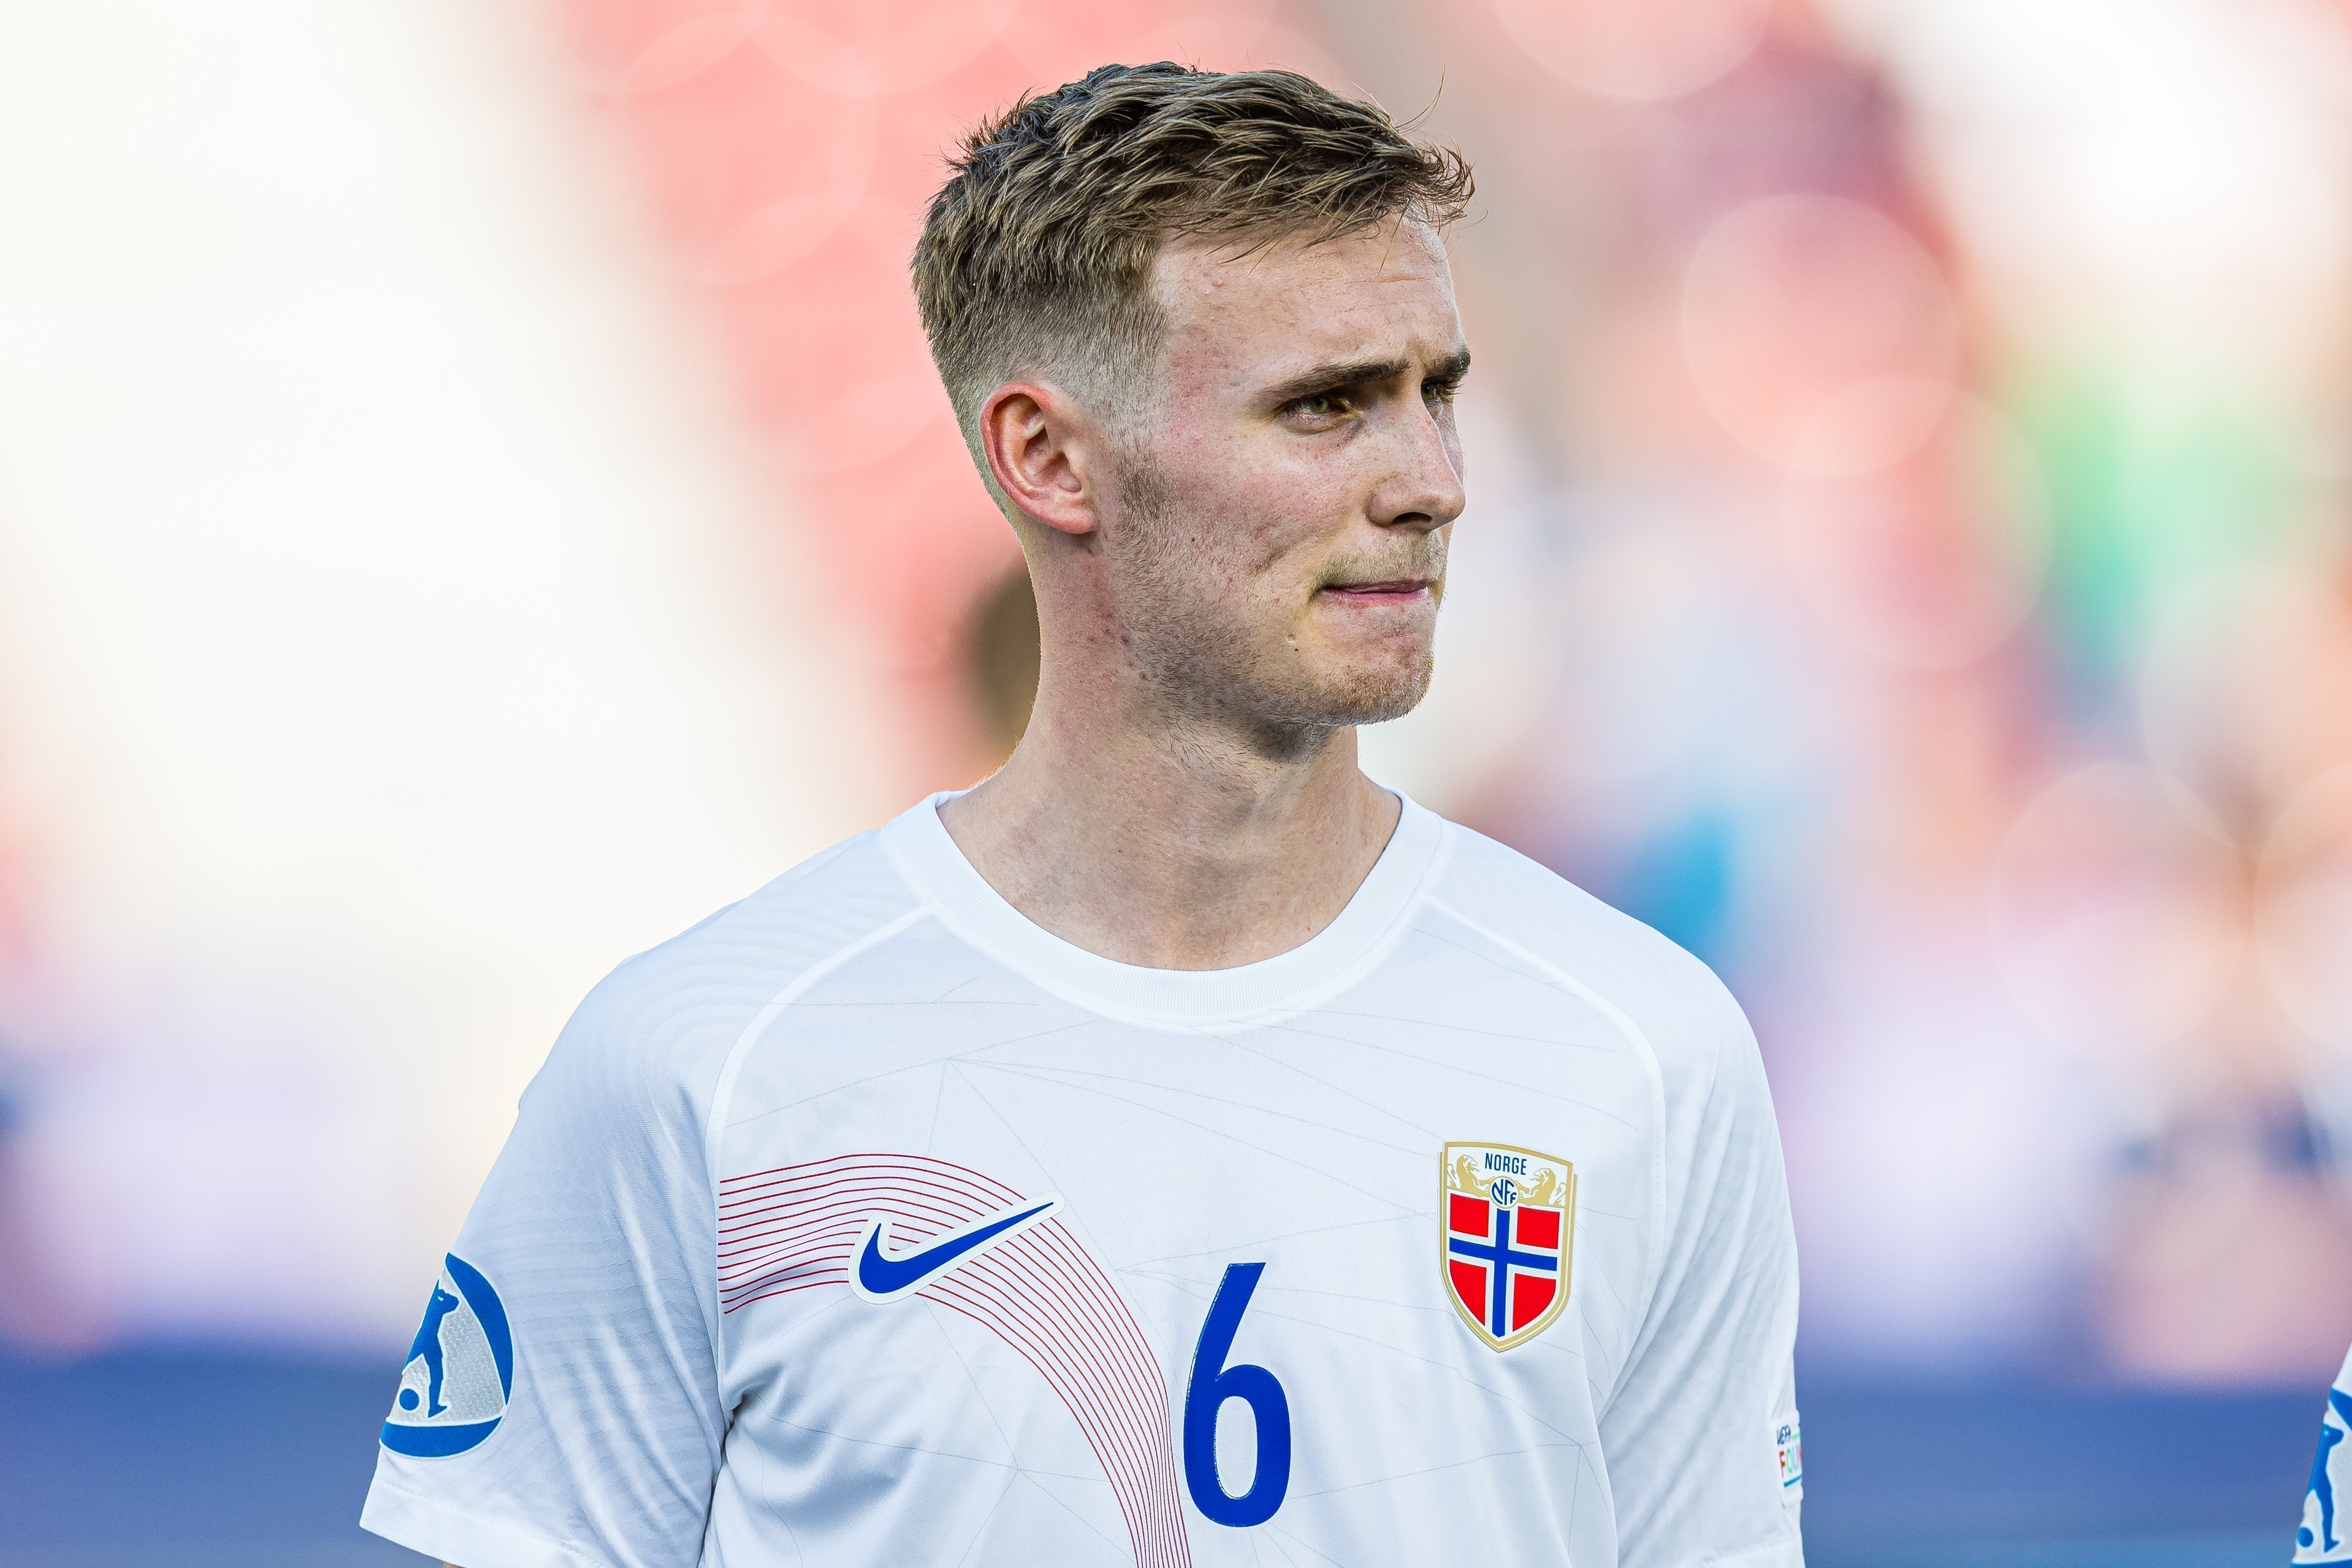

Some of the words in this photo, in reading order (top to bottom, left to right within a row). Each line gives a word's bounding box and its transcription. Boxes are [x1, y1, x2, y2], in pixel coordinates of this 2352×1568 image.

[1485, 1153, 1527, 1175] NORGE
[1492, 1179, 1517, 1205] NFF
[1184, 1262, 1291, 1527] 6
